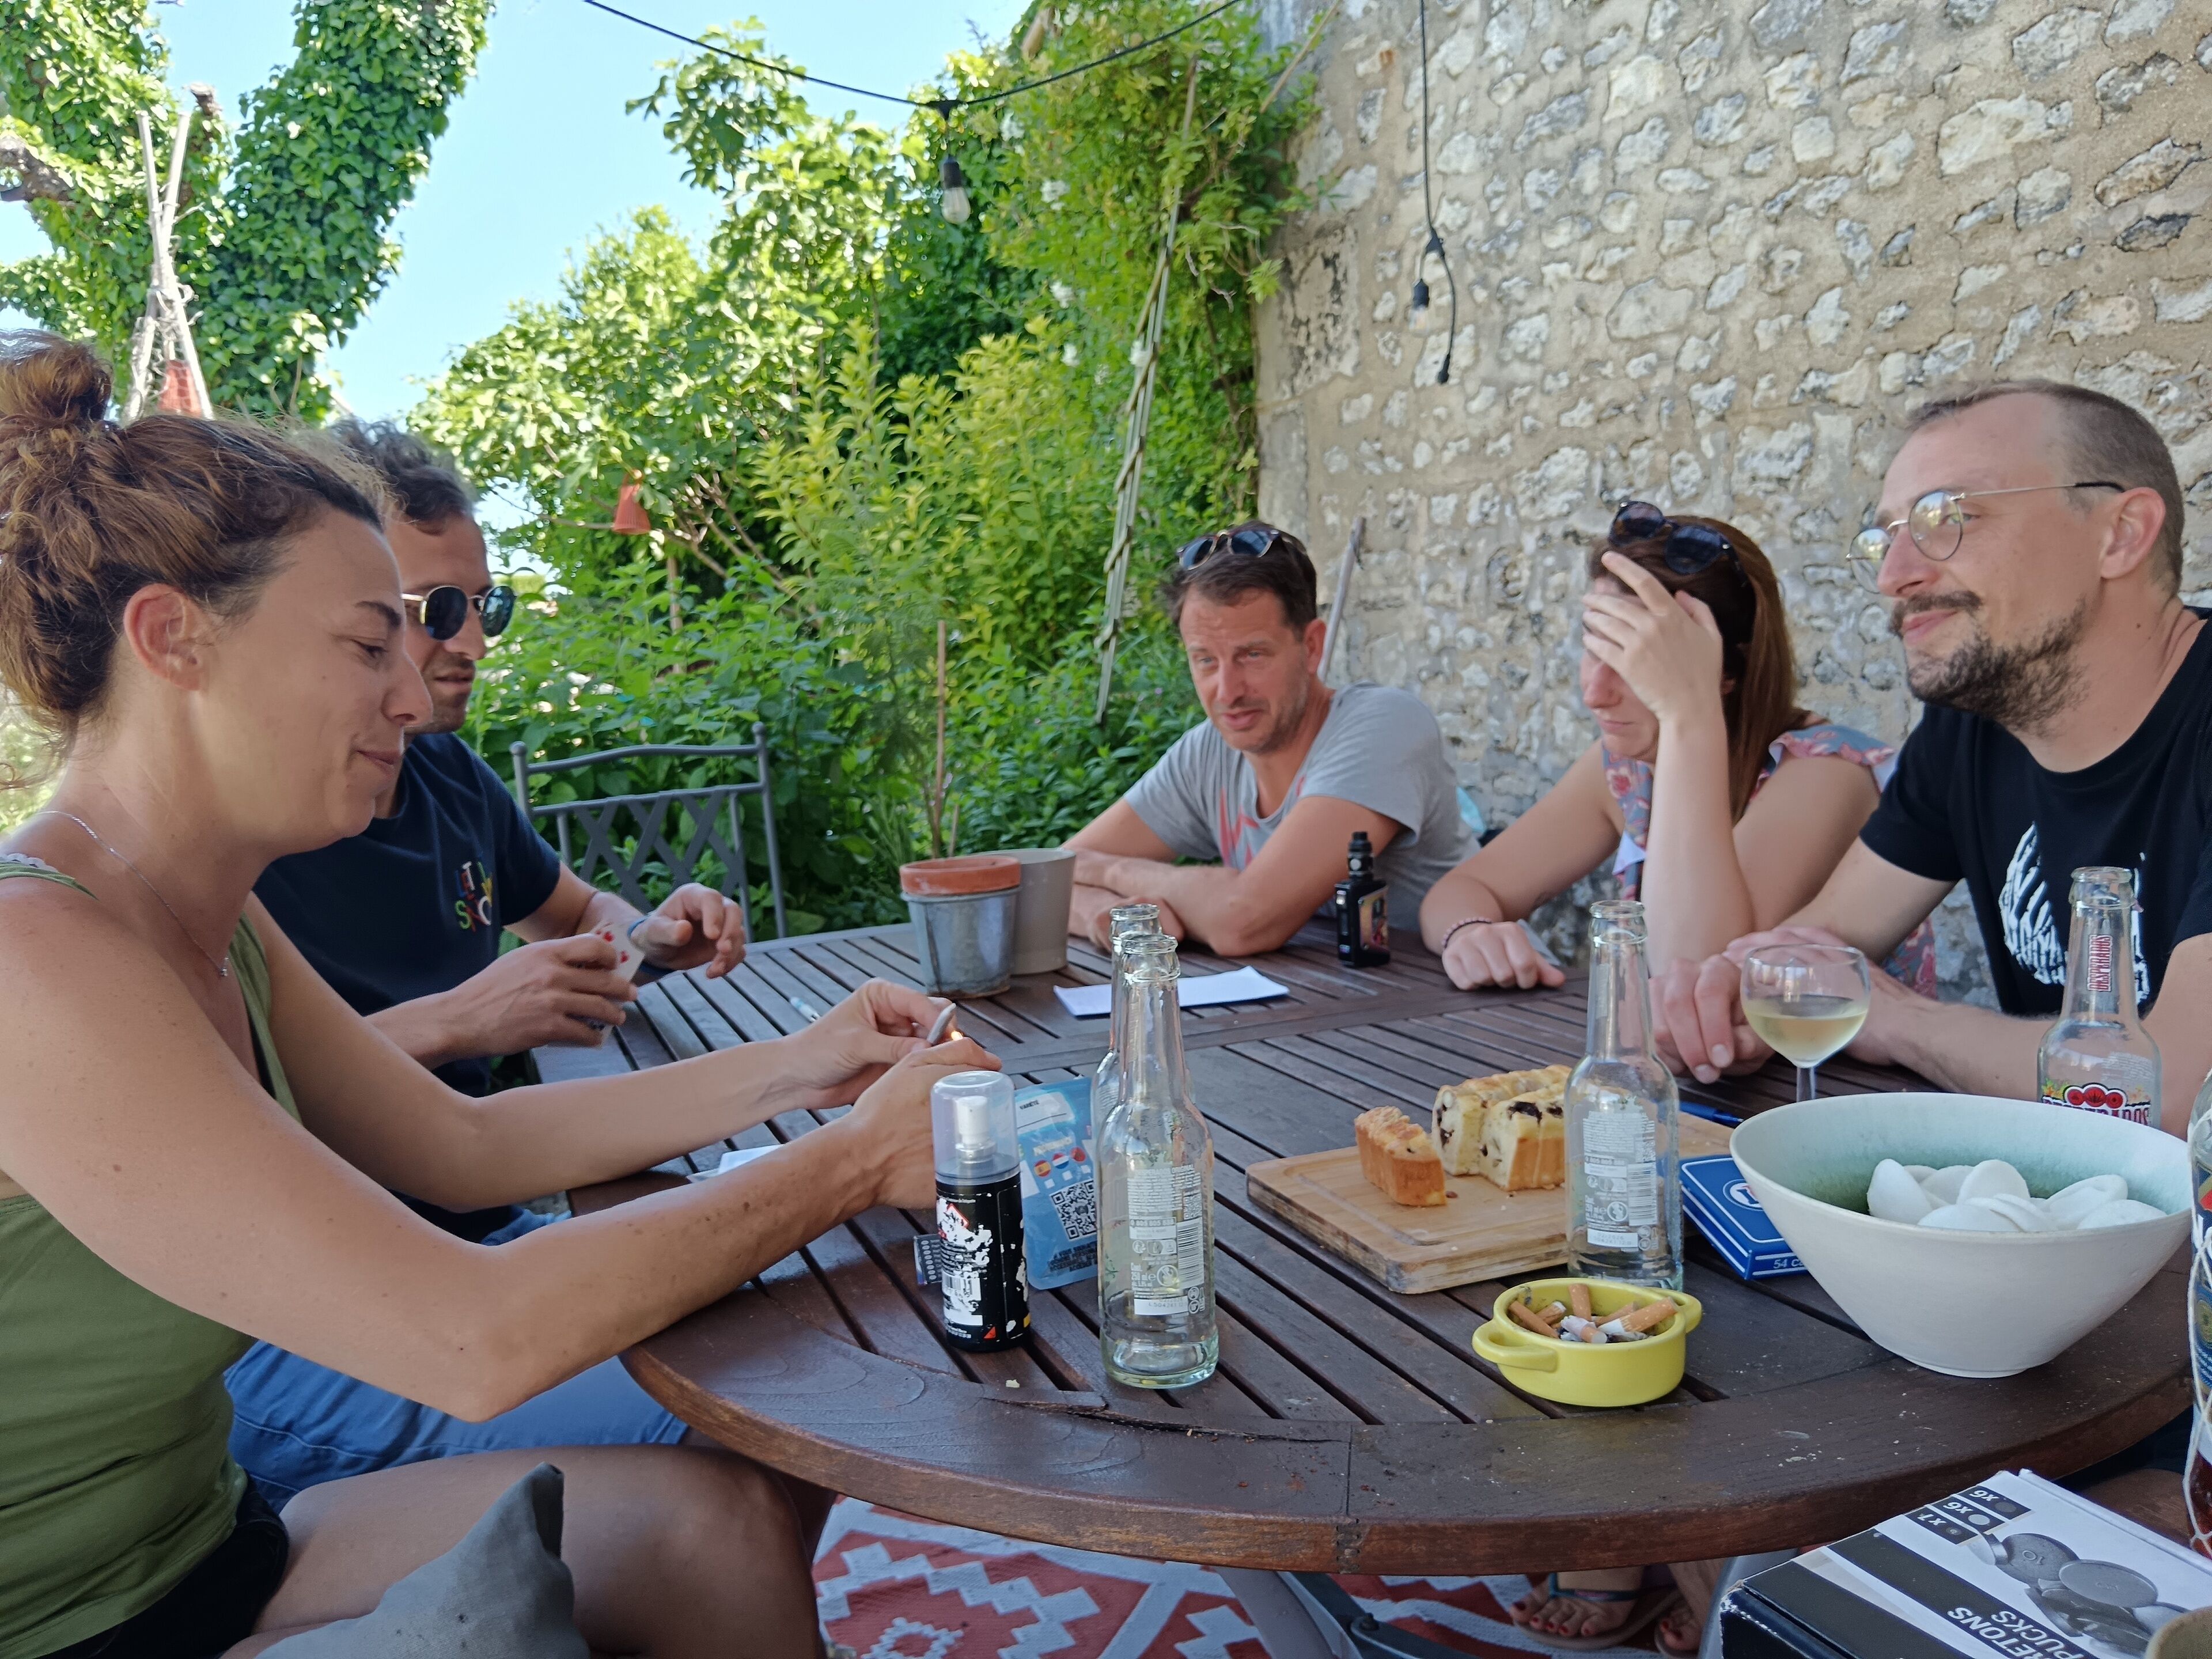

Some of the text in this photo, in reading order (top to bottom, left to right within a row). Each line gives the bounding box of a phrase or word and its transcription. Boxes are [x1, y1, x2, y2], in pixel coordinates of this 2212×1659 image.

[2087, 934, 2112, 991] DESPERADOS
[1773, 1259, 1787, 1269] 54
[1969, 1490, 1999, 1502] x6
[1943, 1501, 1973, 1514] x6
[1991, 1610, 2084, 1659] PUCKS
